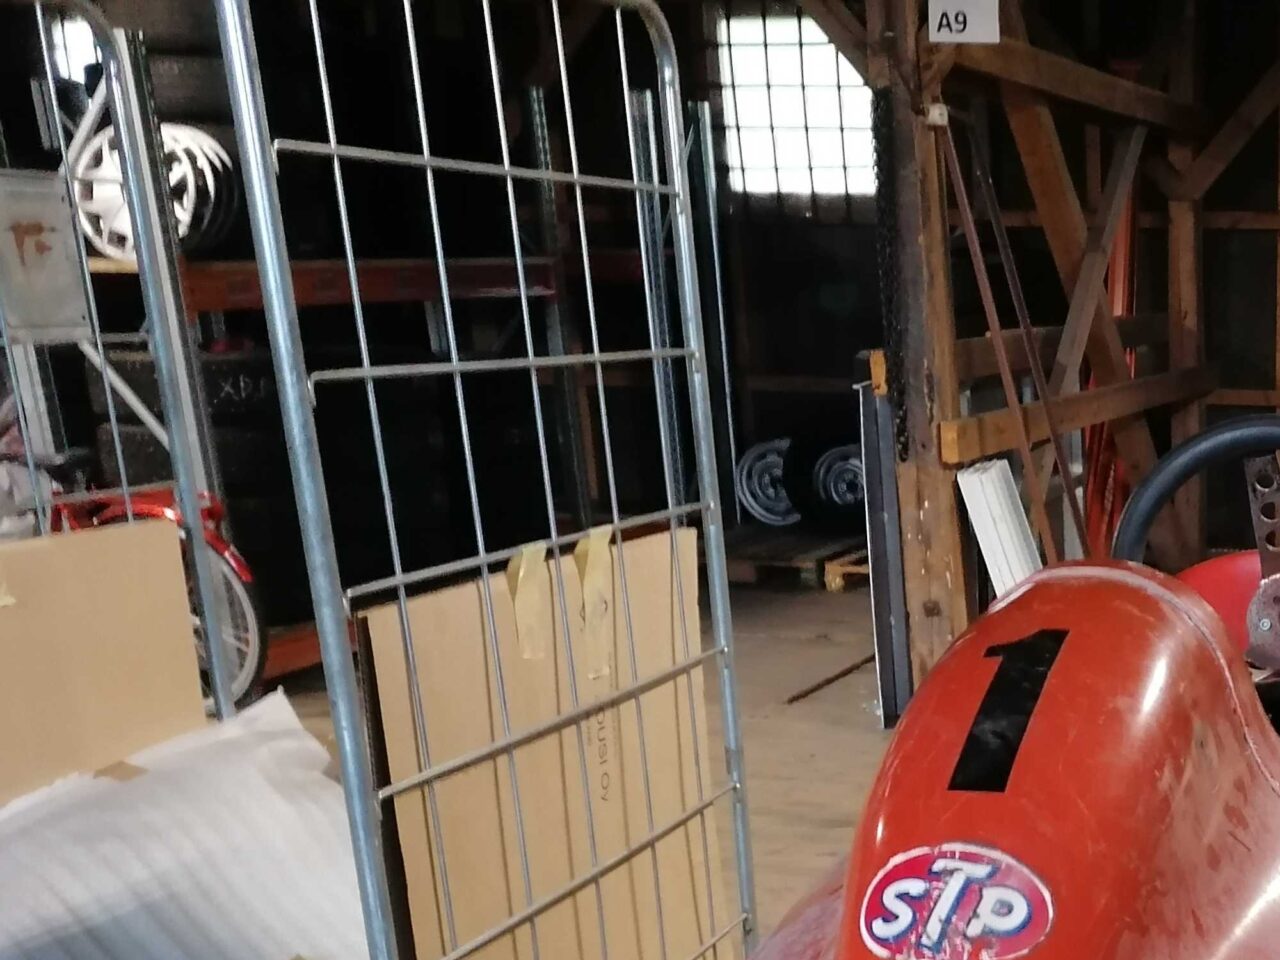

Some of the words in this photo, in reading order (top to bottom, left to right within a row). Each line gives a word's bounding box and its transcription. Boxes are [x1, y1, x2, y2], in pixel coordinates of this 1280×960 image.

[936, 11, 968, 34] A9
[947, 628, 1070, 793] 1
[871, 858, 1031, 951] STP
